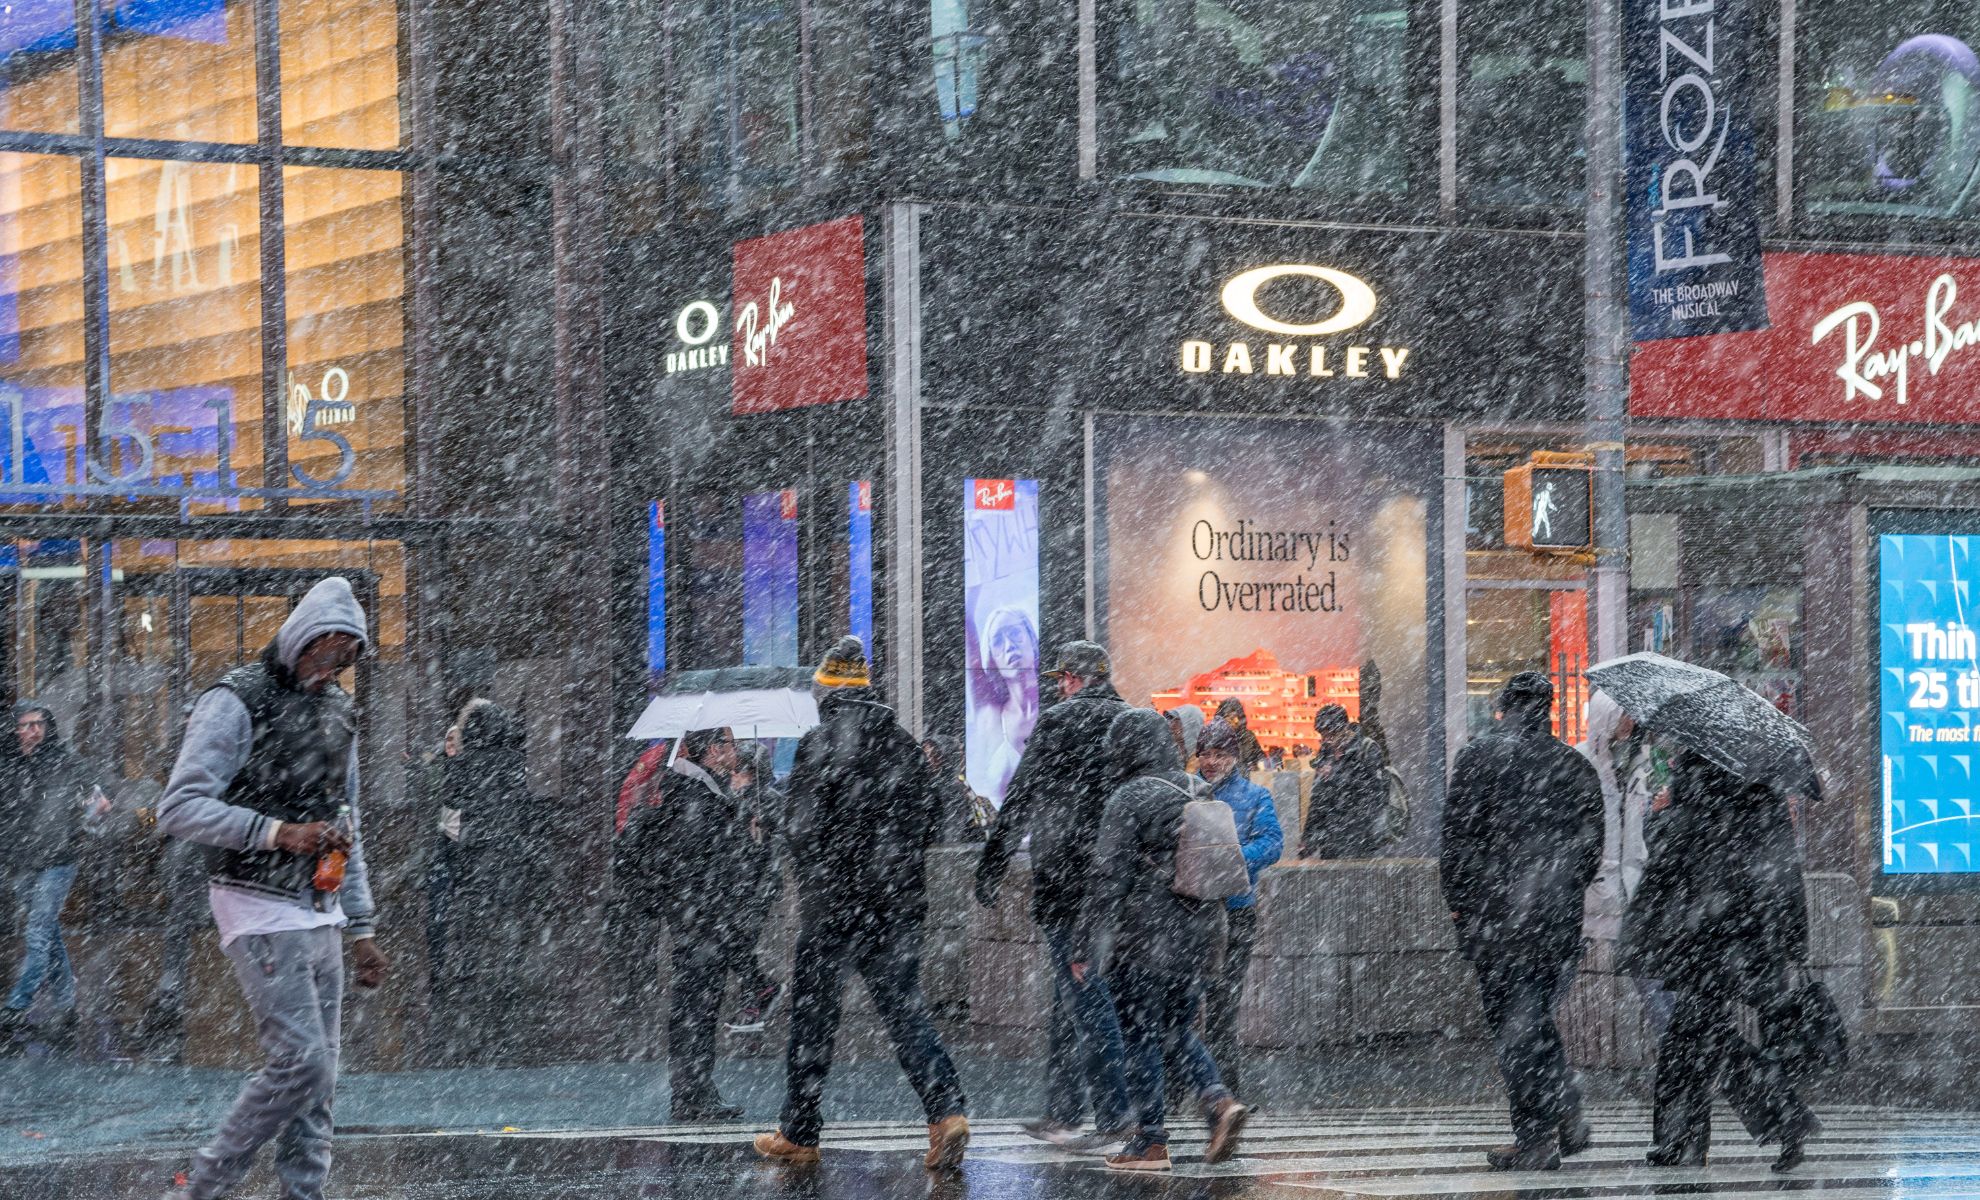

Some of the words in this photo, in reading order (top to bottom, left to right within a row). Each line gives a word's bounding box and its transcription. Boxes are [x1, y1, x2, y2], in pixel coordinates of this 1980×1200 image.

[1653, 287, 1674, 305] THE
[1676, 279, 1740, 303] BROADWAY
[1671, 301, 1722, 321] MUSICAL
[666, 344, 729, 373] OAKLEY
[1182, 340, 1409, 379] OAKLEY
[1192, 519, 1321, 571] Ordinary
[1328, 520, 1350, 562] is
[1199, 570, 1344, 612] Overrated.
[1906, 622, 1976, 660] Thin
[1909, 671, 1949, 709] 25
[1956, 670, 1980, 709] ti
[1909, 725, 1933, 742] The
[1936, 726, 1970, 742] most
